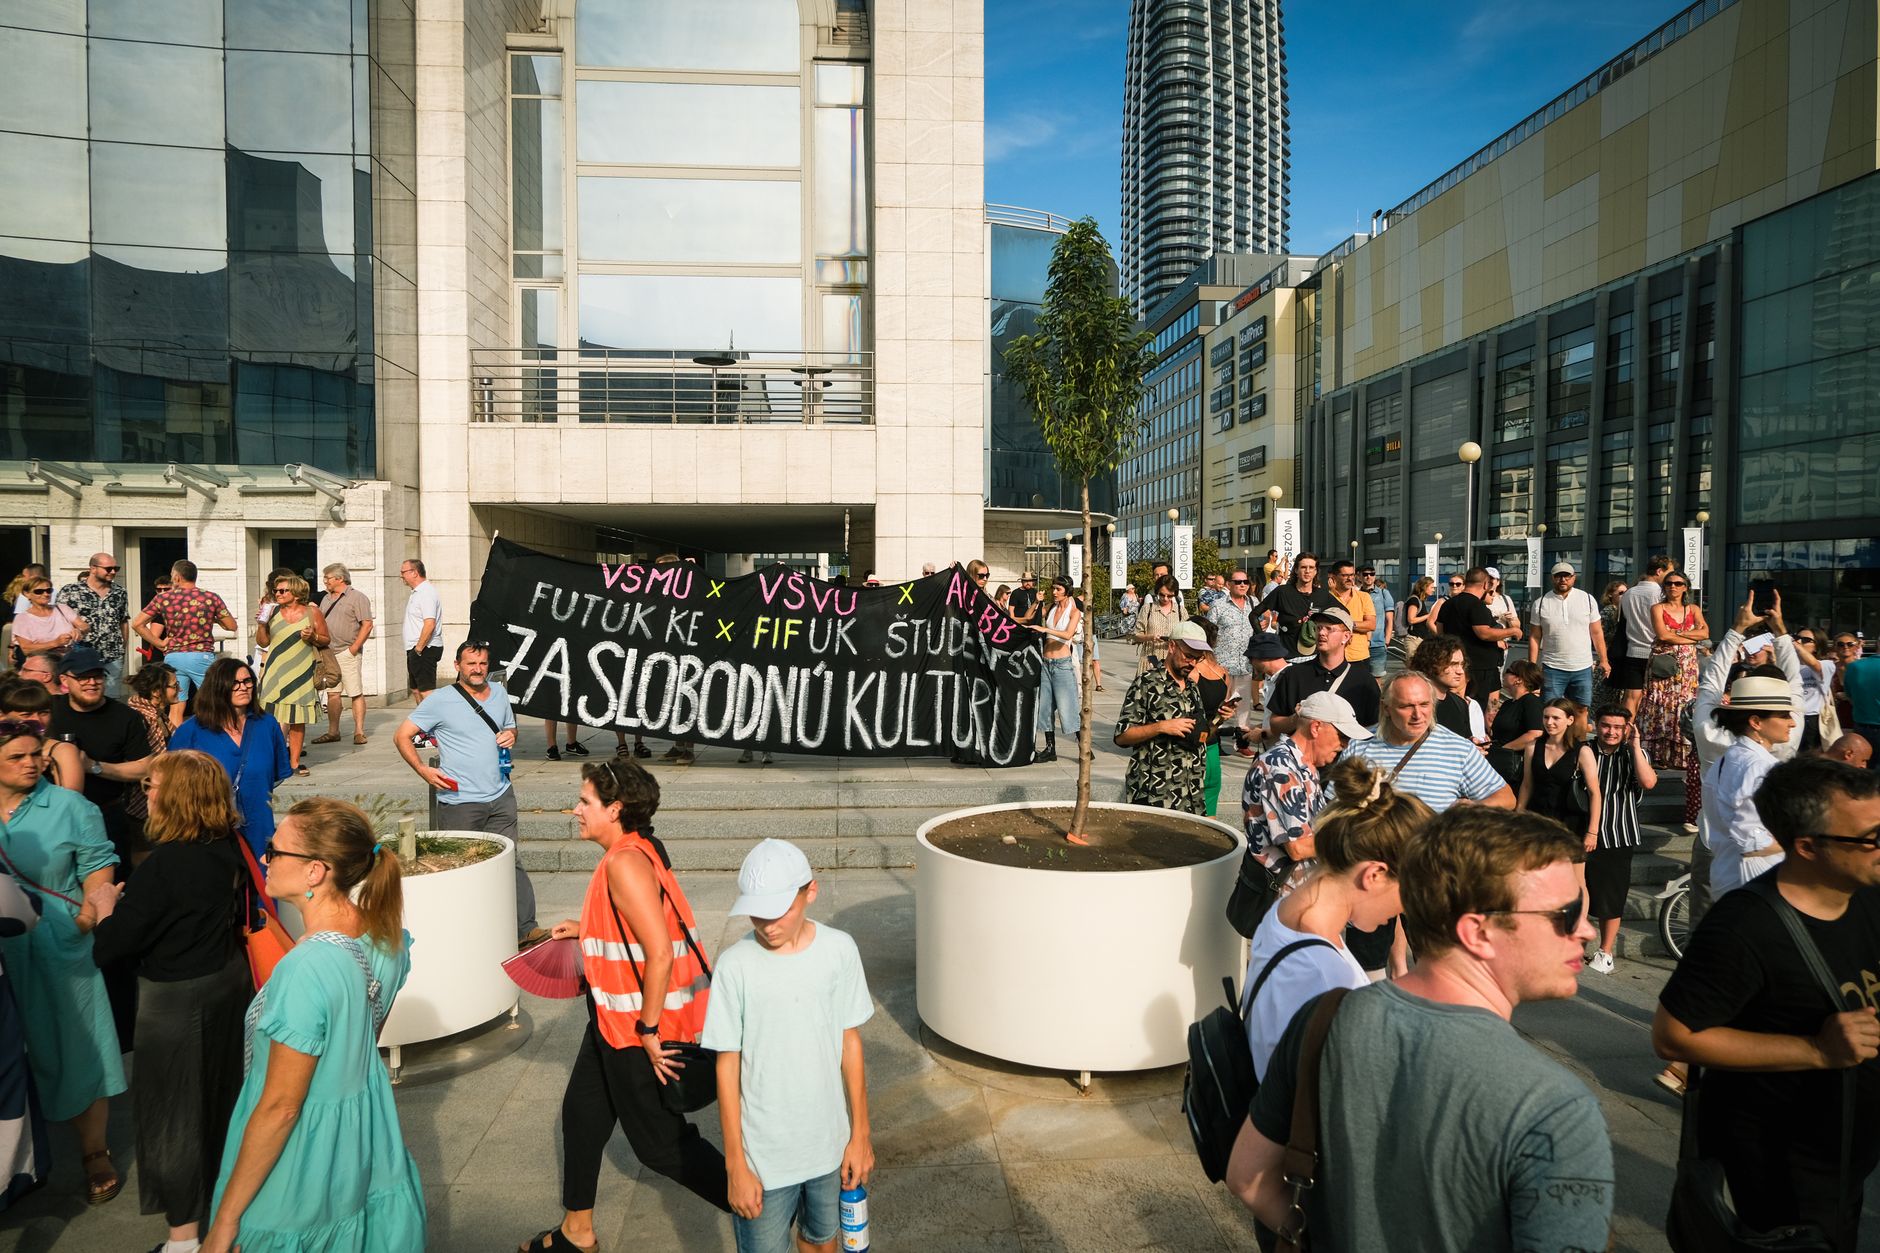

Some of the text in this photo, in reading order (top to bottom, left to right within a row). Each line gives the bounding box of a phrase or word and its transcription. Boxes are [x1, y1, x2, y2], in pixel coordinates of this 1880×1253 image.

[1116, 549, 1124, 577] OPERA
[1178, 534, 1189, 581] ČINOHRA
[1530, 548, 1539, 576] OPERA
[759, 571, 858, 617] VŠVU
[499, 623, 570, 717] ZA
[577, 640, 834, 748] SLOBODNÚ
